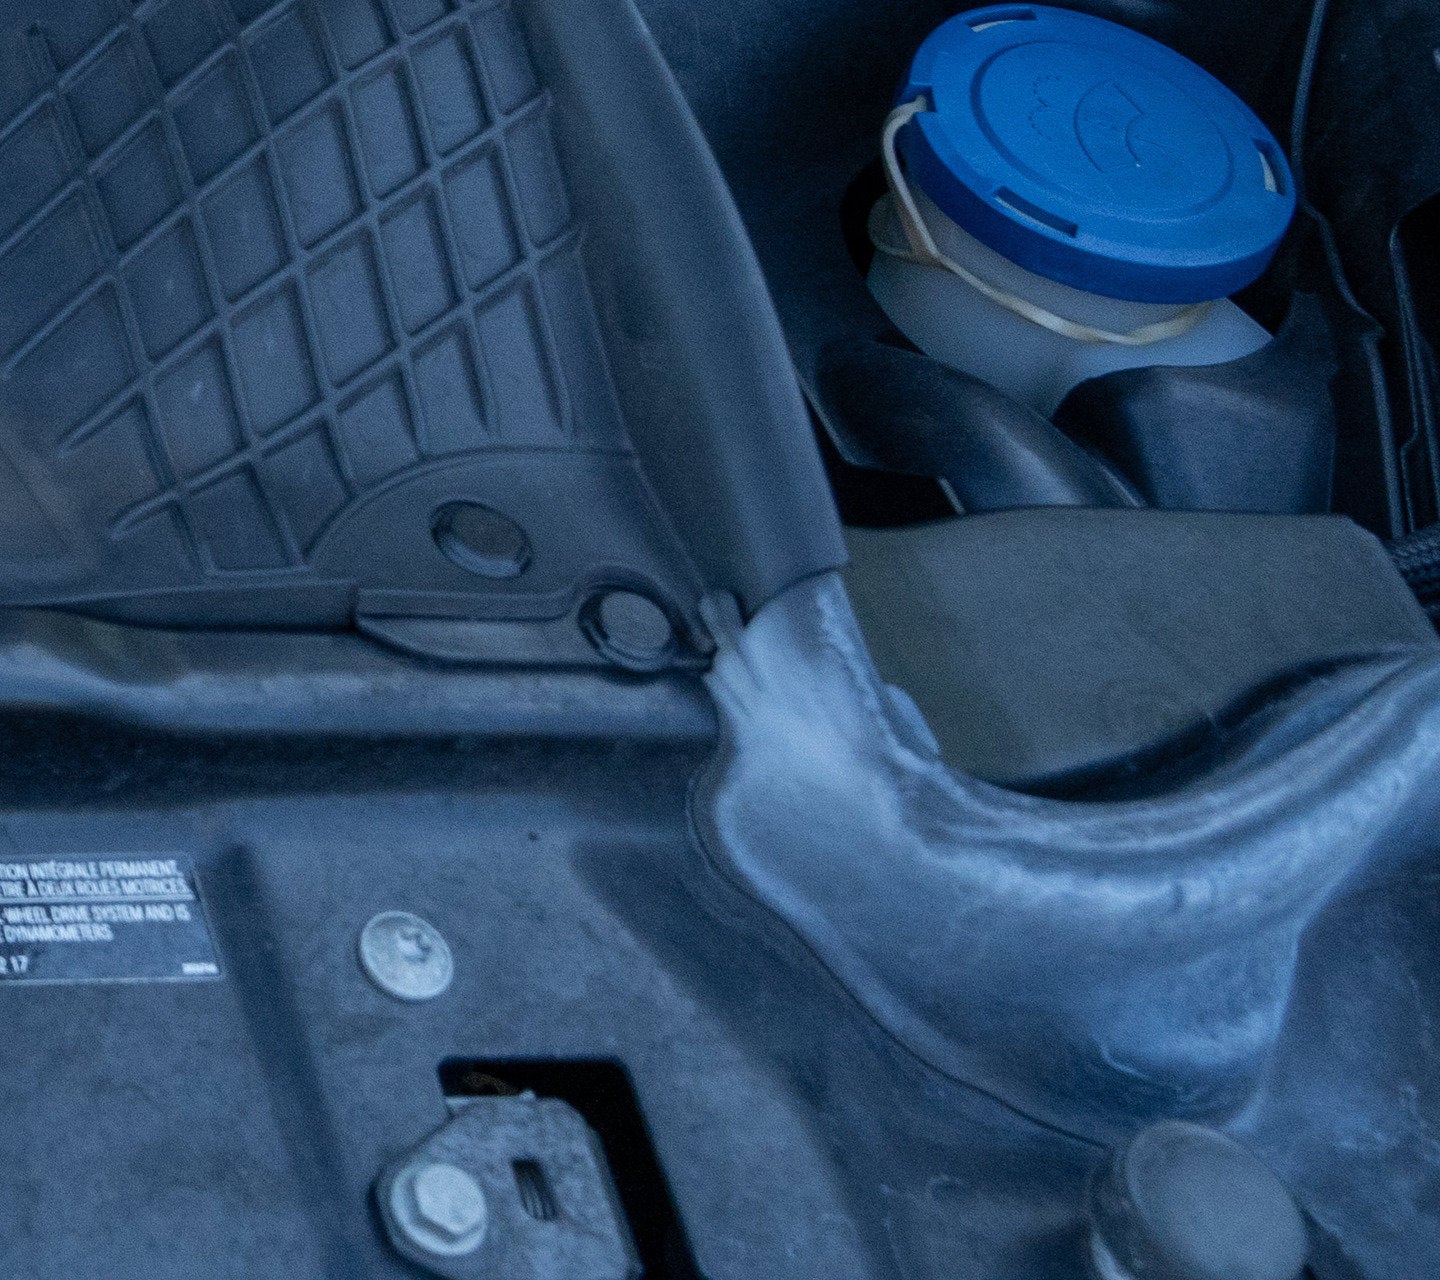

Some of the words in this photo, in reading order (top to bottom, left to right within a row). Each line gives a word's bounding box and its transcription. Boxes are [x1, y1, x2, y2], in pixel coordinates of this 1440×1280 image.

[29, 859, 98, 879] INTÉGRALE
[39, 879, 75, 896] DEUX
[76, 878, 120, 895] ROUES
[52, 905, 91, 923] DRIVE
[91, 904, 144, 922] SYSTEM
[144, 903, 174, 921] AND
[174, 903, 191, 921] IS
[9, 955, 28, 974] 17
